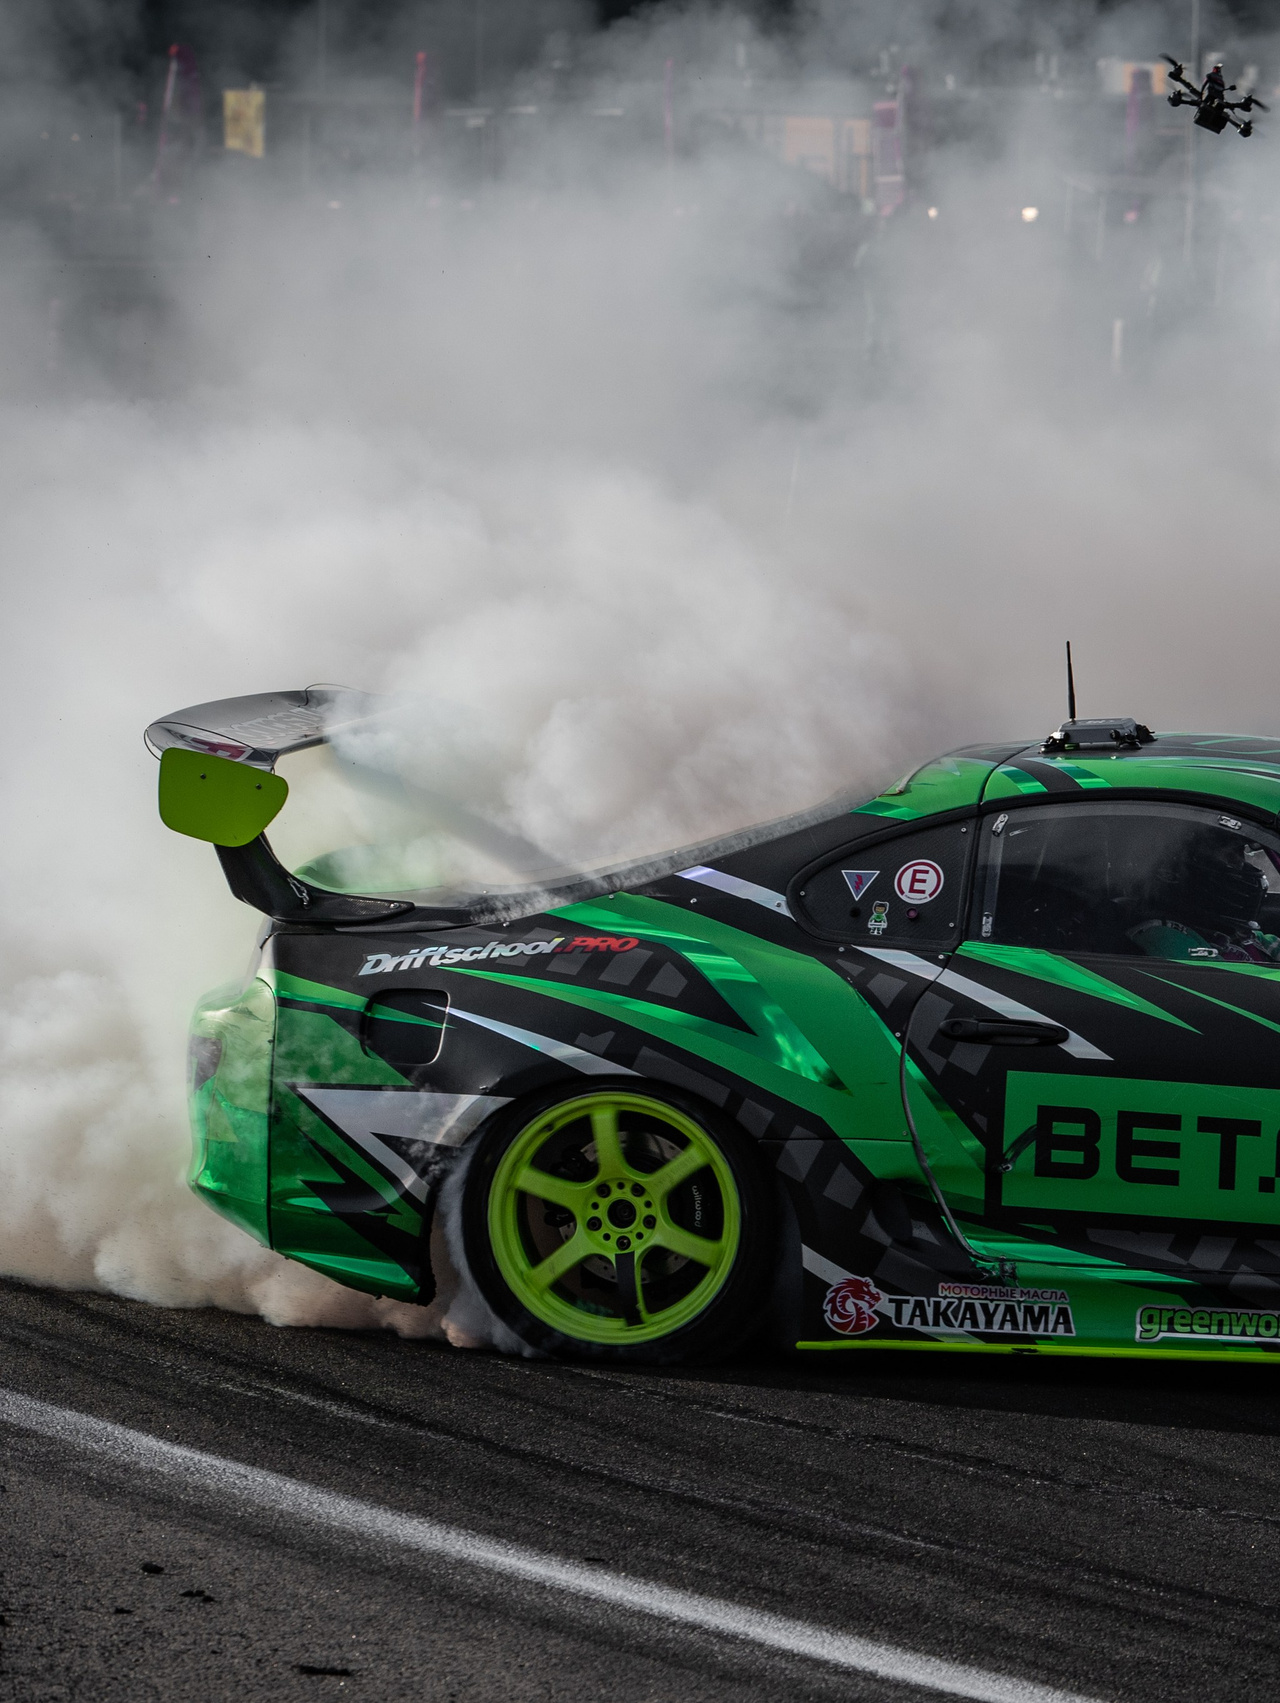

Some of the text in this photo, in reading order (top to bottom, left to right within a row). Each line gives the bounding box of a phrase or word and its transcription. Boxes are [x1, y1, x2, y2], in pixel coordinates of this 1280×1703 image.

[908, 869, 931, 894] E
[358, 937, 640, 976] Driftschool.PRO
[940, 1284, 1068, 1301] МОТОРНЫЕ МАСЛА
[888, 1300, 1075, 1334] TAKAYAMA
